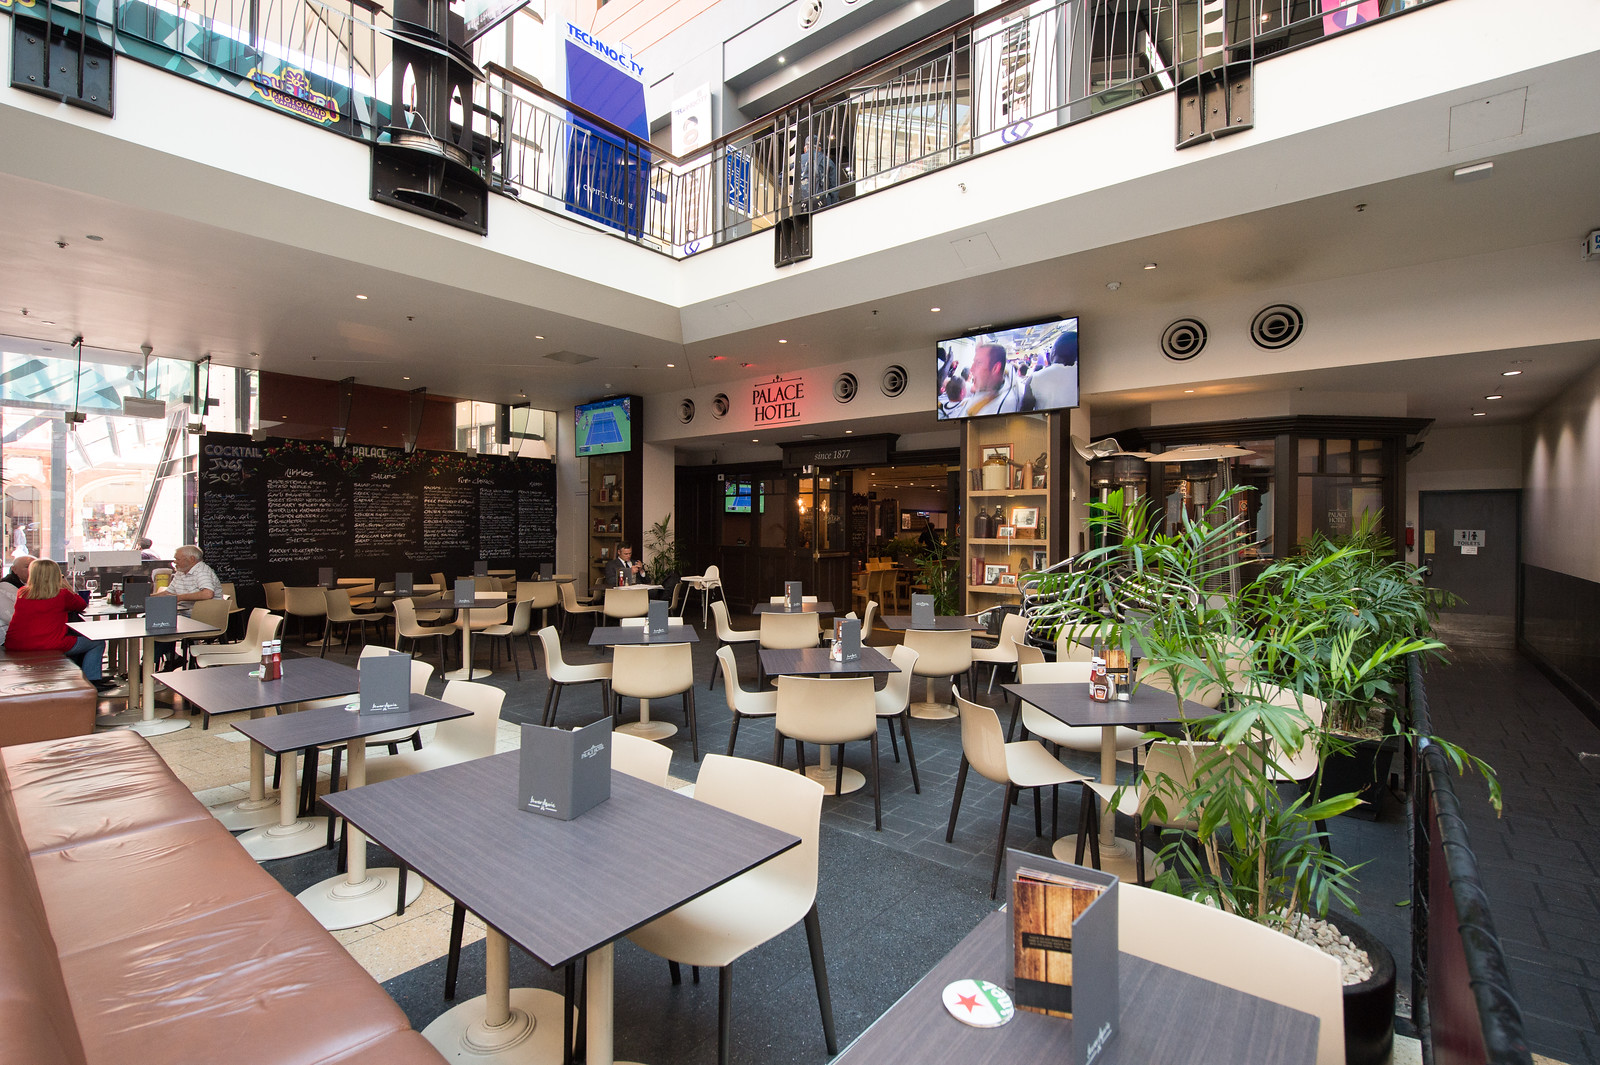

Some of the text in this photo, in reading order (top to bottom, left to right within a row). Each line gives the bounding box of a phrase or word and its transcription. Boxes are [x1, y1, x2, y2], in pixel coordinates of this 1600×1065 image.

[566, 22, 645, 76] TECHNOCTY
[752, 382, 804, 405] PALACE
[755, 402, 801, 421] HOTEL
[204, 444, 264, 458] COCKTAIL
[352, 446, 388, 458] PALACE
[814, 449, 851, 460] since 1877
[208, 457, 243, 471] JUGS
